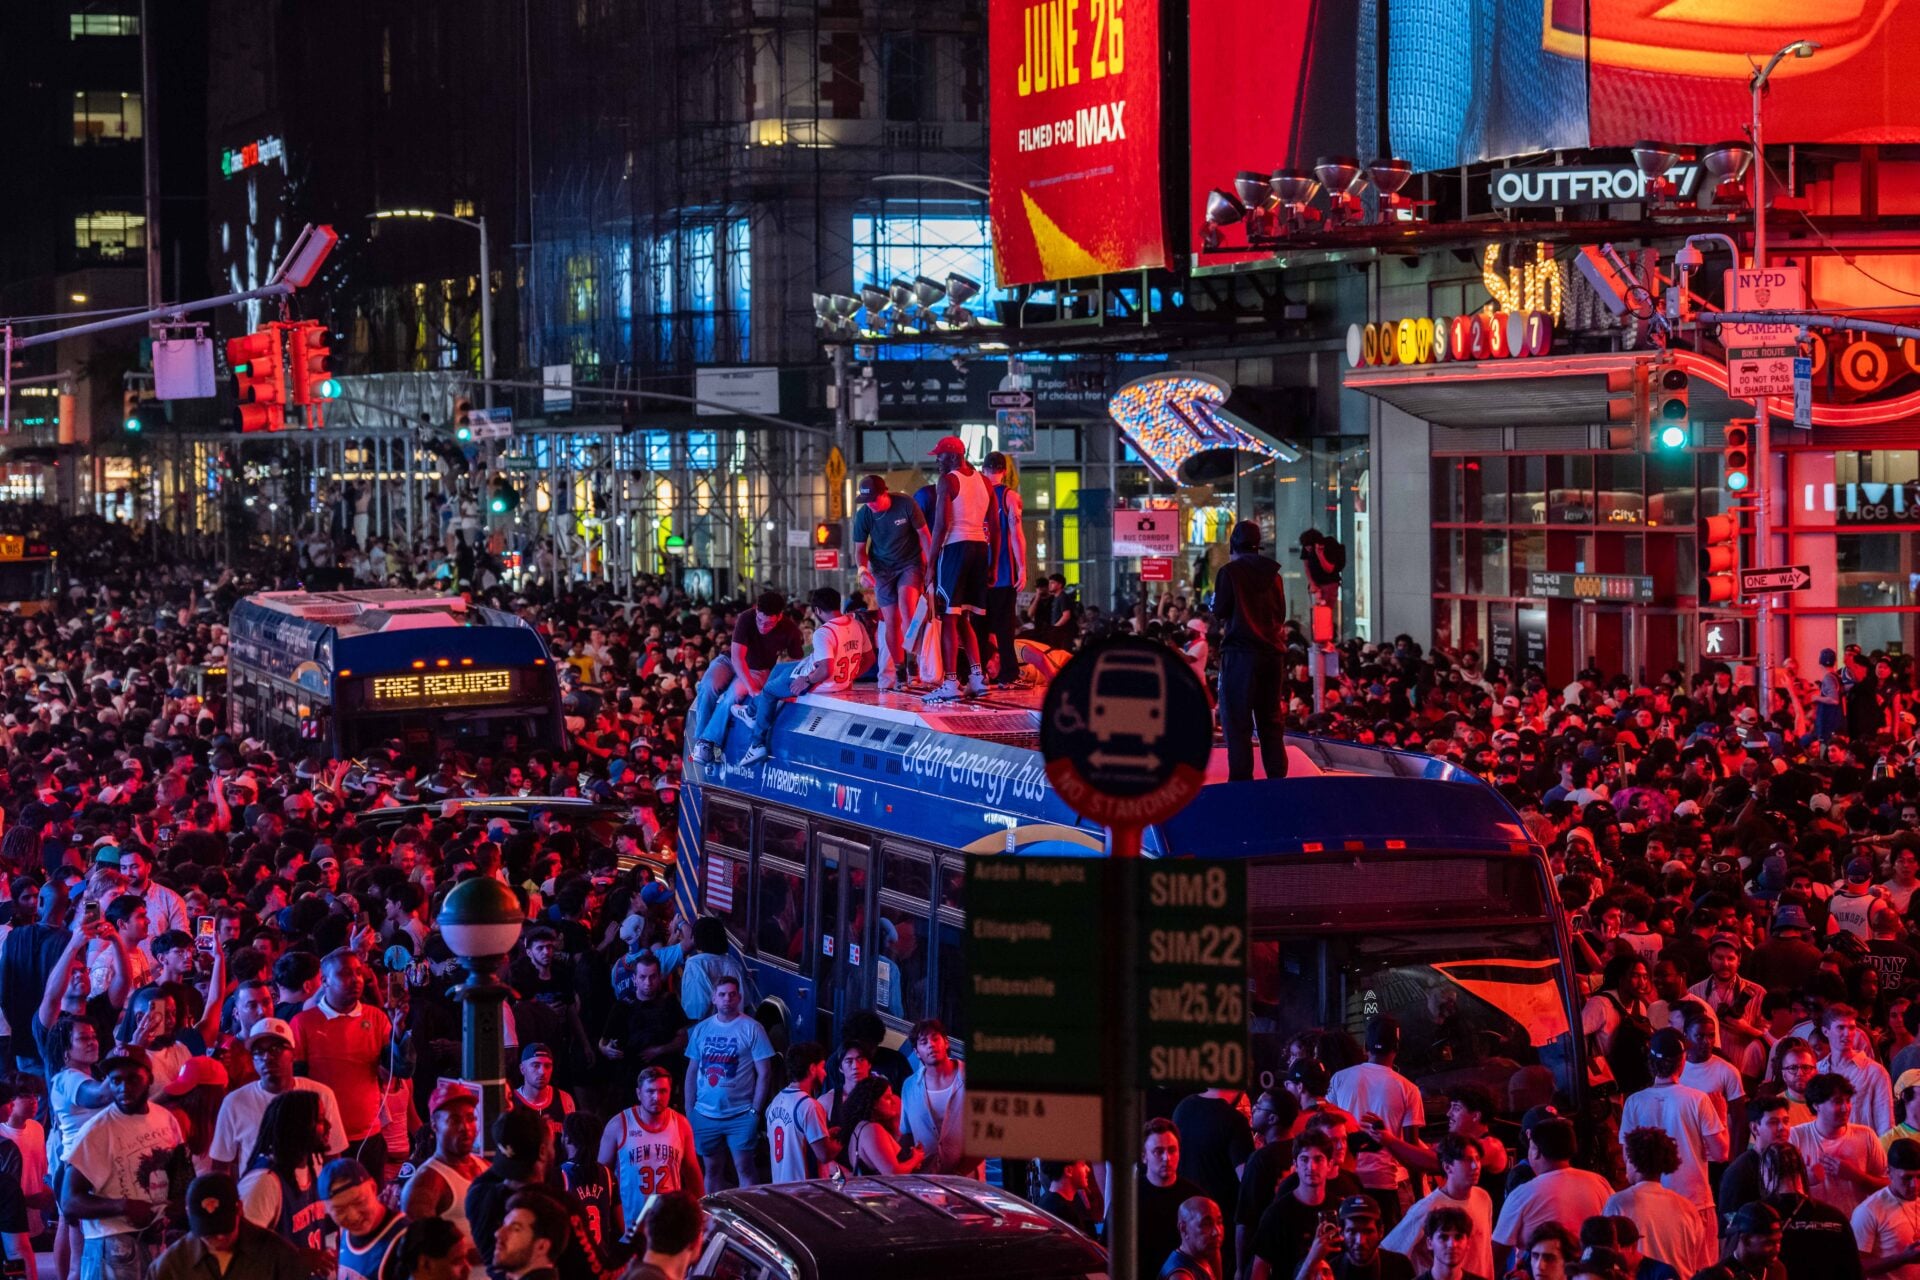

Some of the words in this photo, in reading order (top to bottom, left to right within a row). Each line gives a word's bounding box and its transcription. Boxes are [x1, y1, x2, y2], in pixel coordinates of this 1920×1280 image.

[1018, 0, 1080, 97] JUNE
[1090, 0, 1124, 80] 26
[1019, 124, 1053, 153] FILMED
[1055, 119, 1074, 145] FOR
[1076, 100, 1126, 148] IMAX
[1739, 273, 1786, 288] NYPD
[1365, 335, 1375, 357] N
[1383, 333, 1391, 356] Q
[1400, 329, 1407, 354] R
[1416, 328, 1427, 354] W
[1435, 321, 1444, 353] S
[1454, 323, 1461, 352] 1
[1472, 322, 1481, 351] 2
[1491, 320, 1500, 350] 3
[1530, 317, 1538, 348] 7
[1735, 322, 1793, 335] CAMERA
[1741, 349, 1758, 358] BIKE
[1761, 347, 1786, 357] ROUTE
[1850, 349, 1879, 383] Q
[1733, 386, 1741, 394] IN
[1744, 385, 1774, 394] SHARED
[1776, 384, 1794, 393] LAN
[1739, 376, 1750, 385] DO
[1753, 375, 1768, 384] NOT
[1770, 374, 1790, 383] PASS
[1037, 391, 1047, 401] of
[1612, 509, 1635, 522] City
[1746, 575, 1768, 587] ONE
[1778, 573, 1802, 585] WAY
[833, 652, 861, 683] 32
[374, 676, 420, 699] FARE
[424, 671, 510, 696] REQUIRED
[902, 733, 1019, 806] clean-energy
[1012, 754, 1047, 802] bus
[844, 785, 862, 814] NY
[1056, 771, 1086, 801] NO
[1088, 776, 1190, 818] STANDING
[1150, 866, 1227, 909] SIM8
[1150, 923, 1243, 967] SIM22
[1150, 981, 1243, 1025] SIM25,26
[1150, 1039, 1243, 1083] SIM30
[971, 1098, 986, 1114] W
[991, 1098, 1009, 1116] 42
[1013, 1099, 1029, 1117] St
[972, 1120, 981, 1139] 7
[628, 1144, 652, 1166] NEW
[654, 1143, 680, 1162] YORK
[774, 1125, 785, 1164] 8
[576, 1183, 604, 1200] HART
[638, 1165, 670, 1195] 32
[585, 1205, 601, 1246] 3
